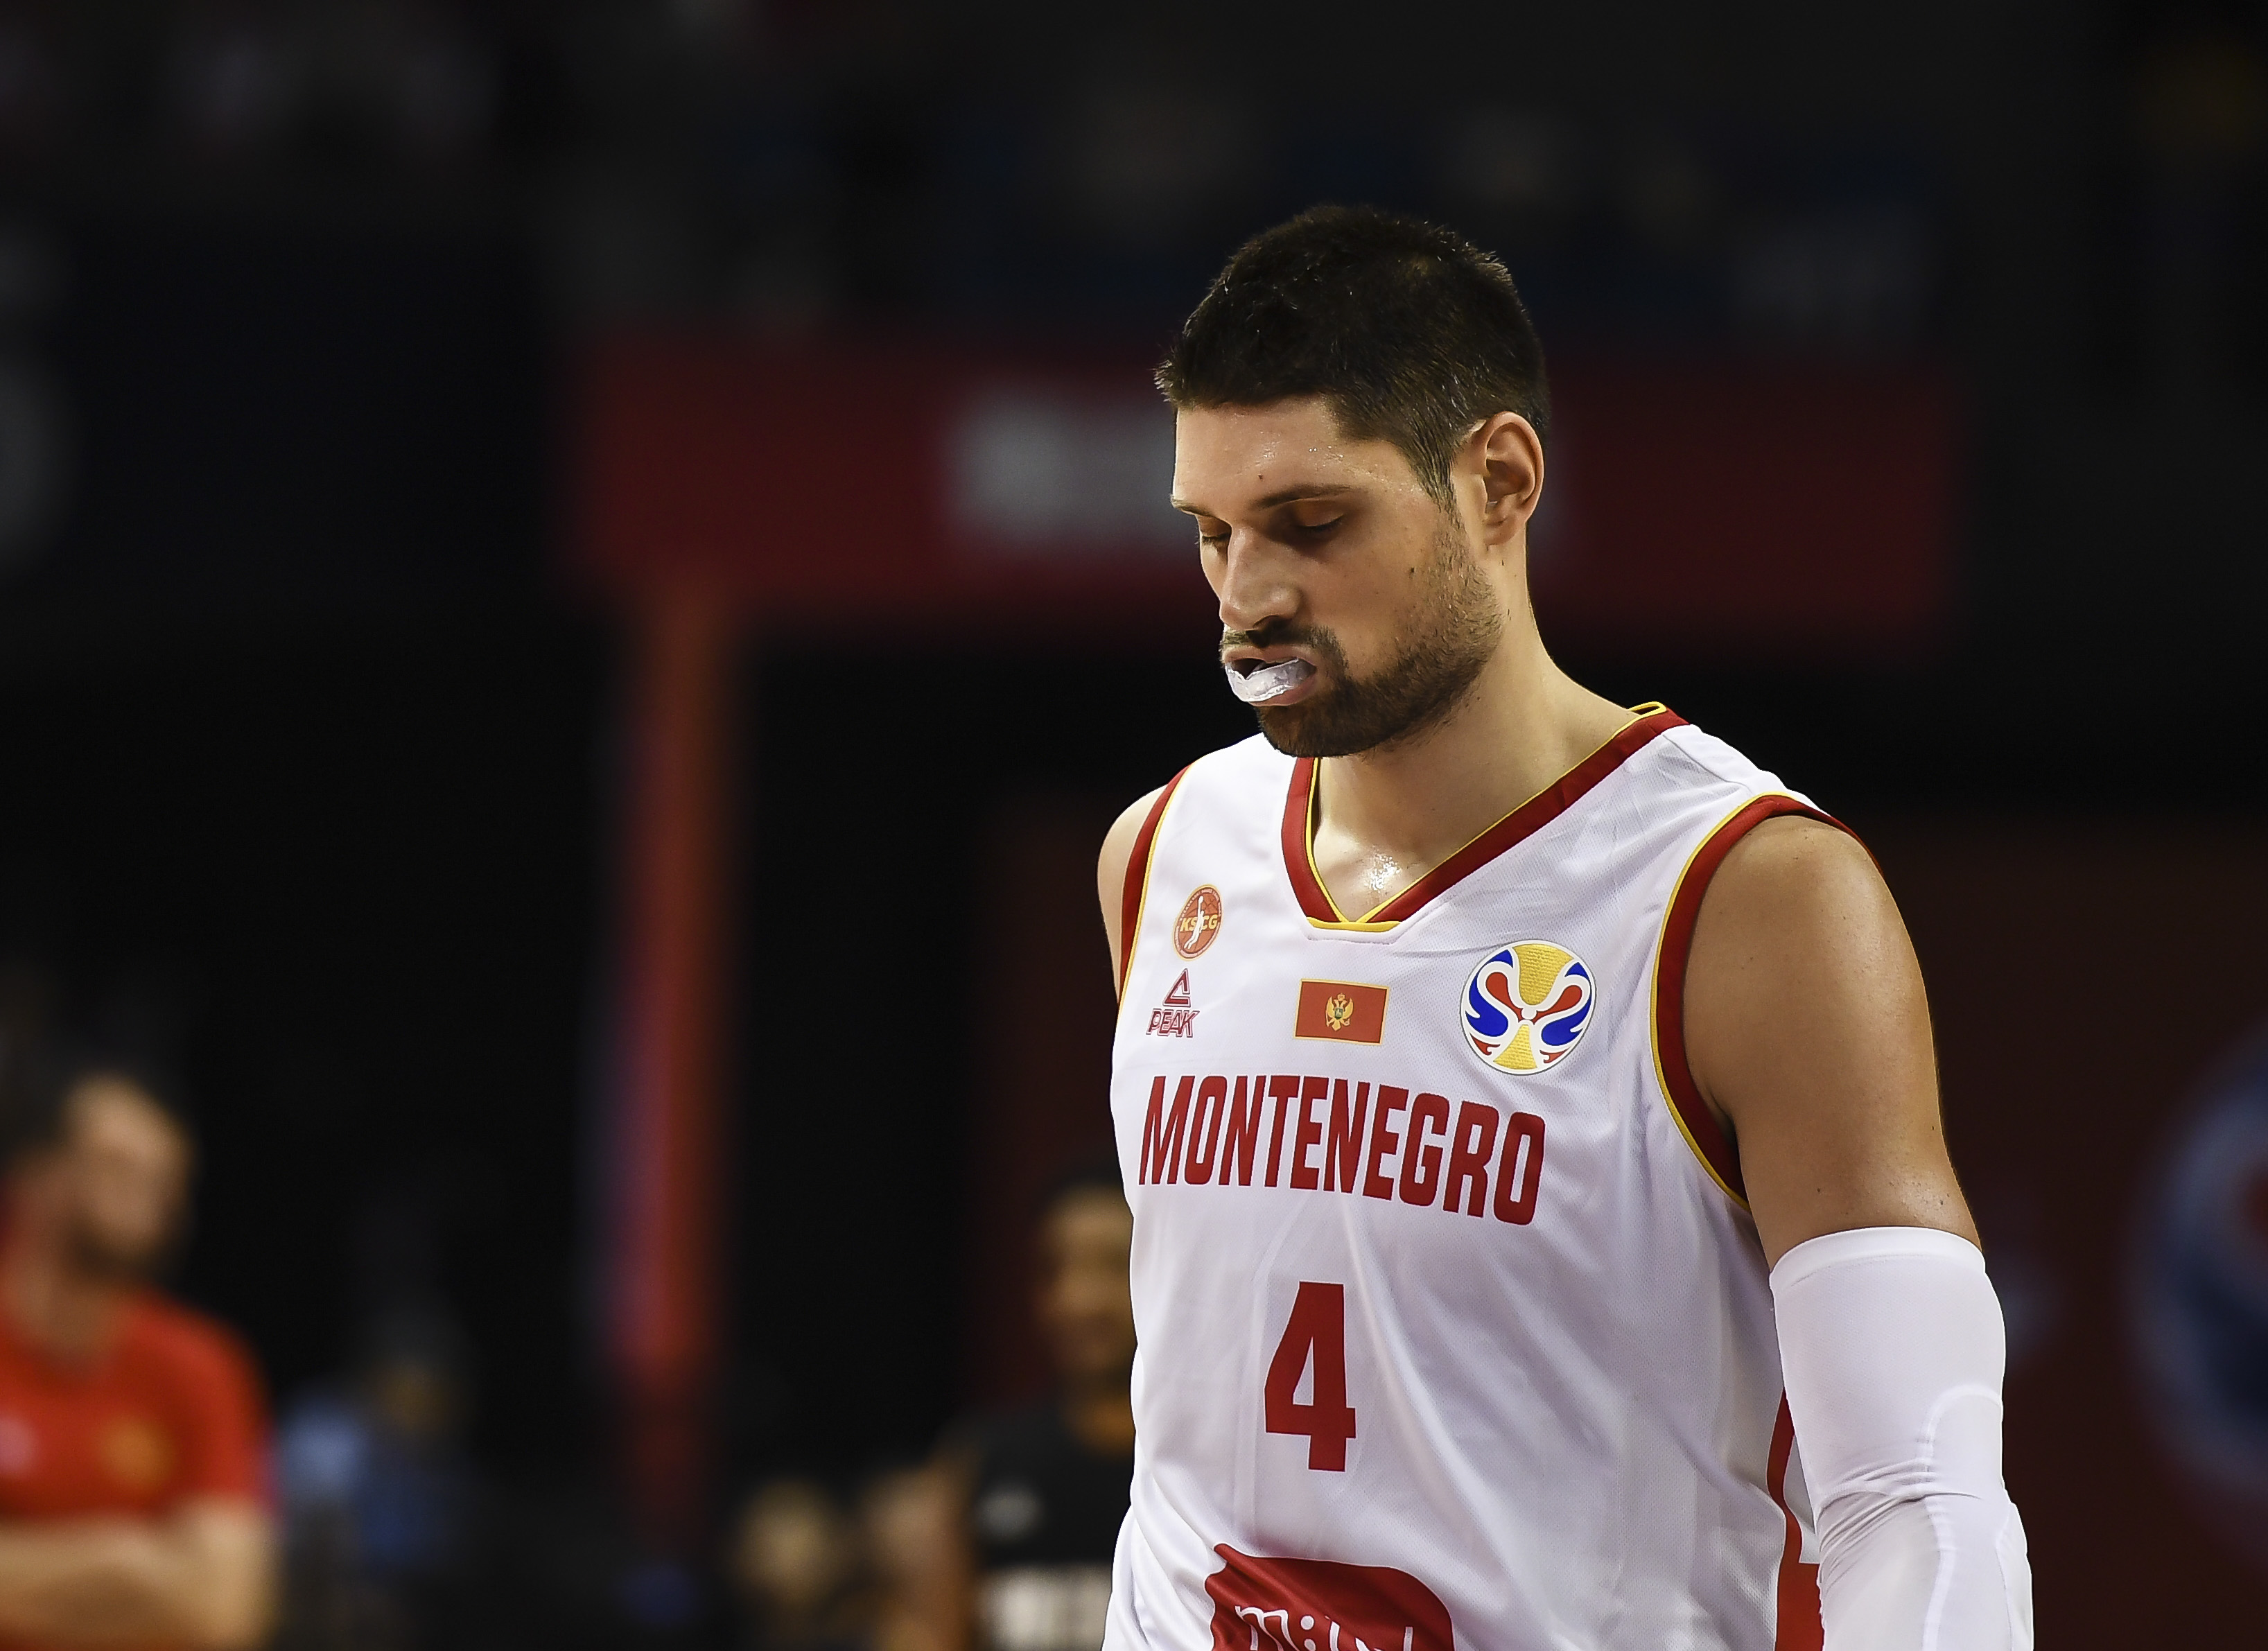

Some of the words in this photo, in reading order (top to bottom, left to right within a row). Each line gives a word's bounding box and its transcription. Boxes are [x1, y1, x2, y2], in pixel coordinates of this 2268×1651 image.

[1180, 914, 1219, 932] KSCG
[1146, 1008, 1200, 1038] PEAK
[1138, 1075, 1546, 1226] MONTENEGRO
[1264, 1281, 1357, 1472] 4
